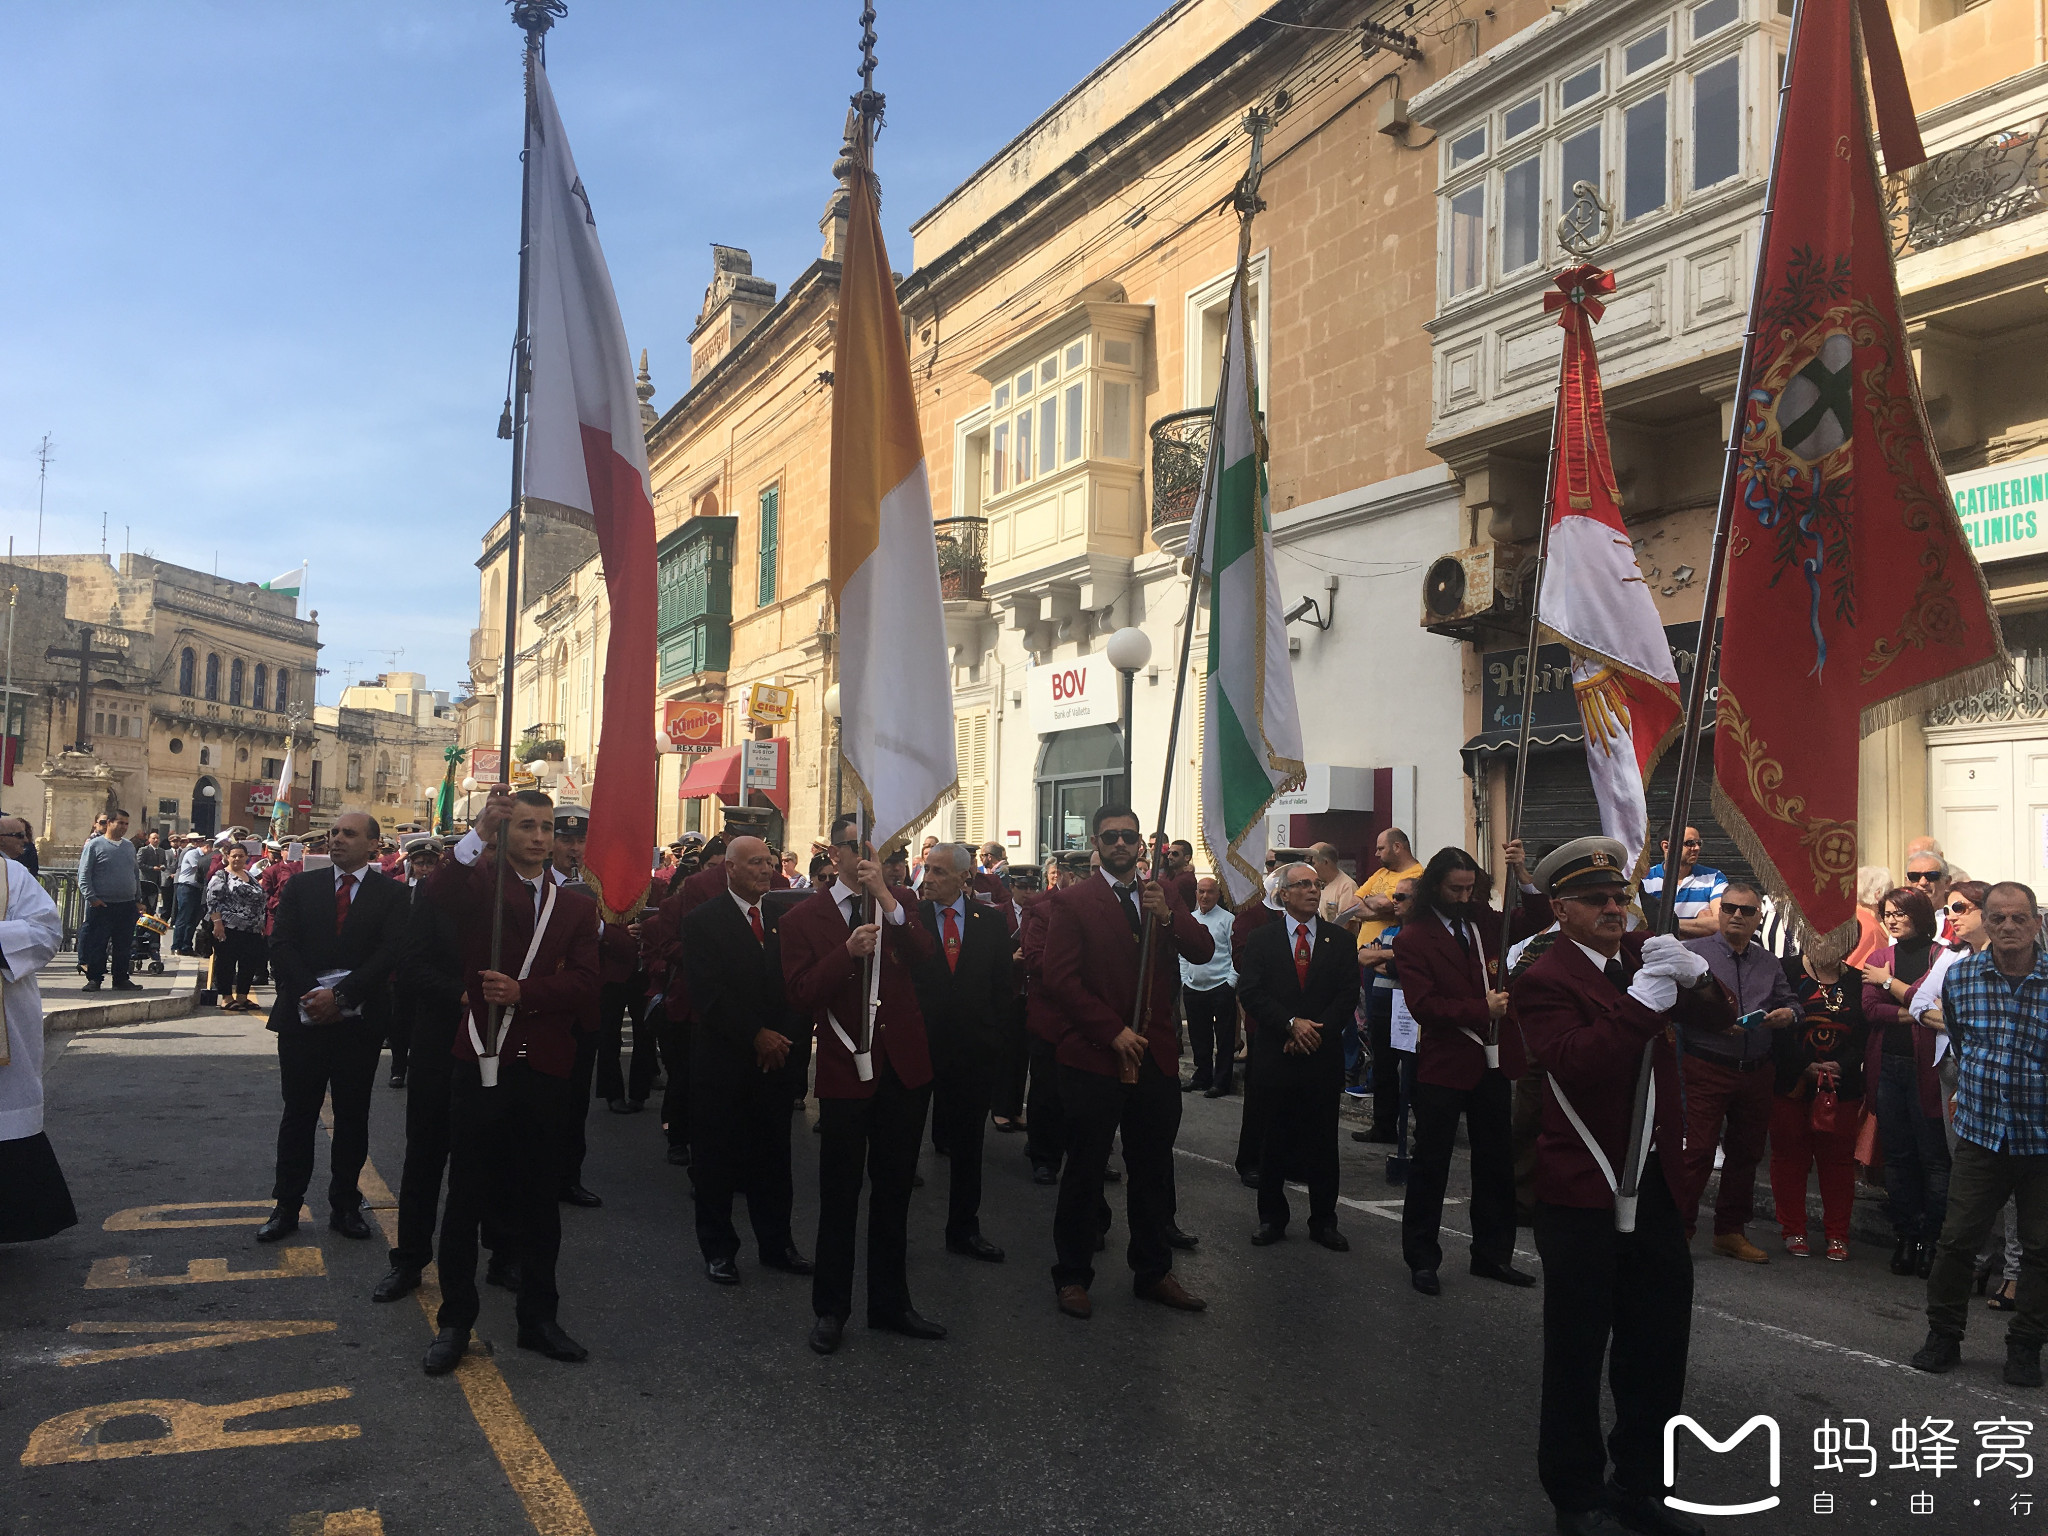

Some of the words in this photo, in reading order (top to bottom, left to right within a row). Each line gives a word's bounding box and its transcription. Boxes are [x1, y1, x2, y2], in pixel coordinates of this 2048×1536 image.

[1955, 472, 2048, 518] CATHERIN
[1052, 667, 1087, 700] BOV
[757, 702, 783, 714] CISK
[1054, 710, 1066, 720] Bank
[1066, 708, 1072, 718] of
[1072, 707, 1091, 717] Valletta
[671, 710, 718, 737] Kinnie
[676, 744, 694, 752] REX
[696, 745, 713, 753] BAR
[1968, 769, 1976, 780] 3
